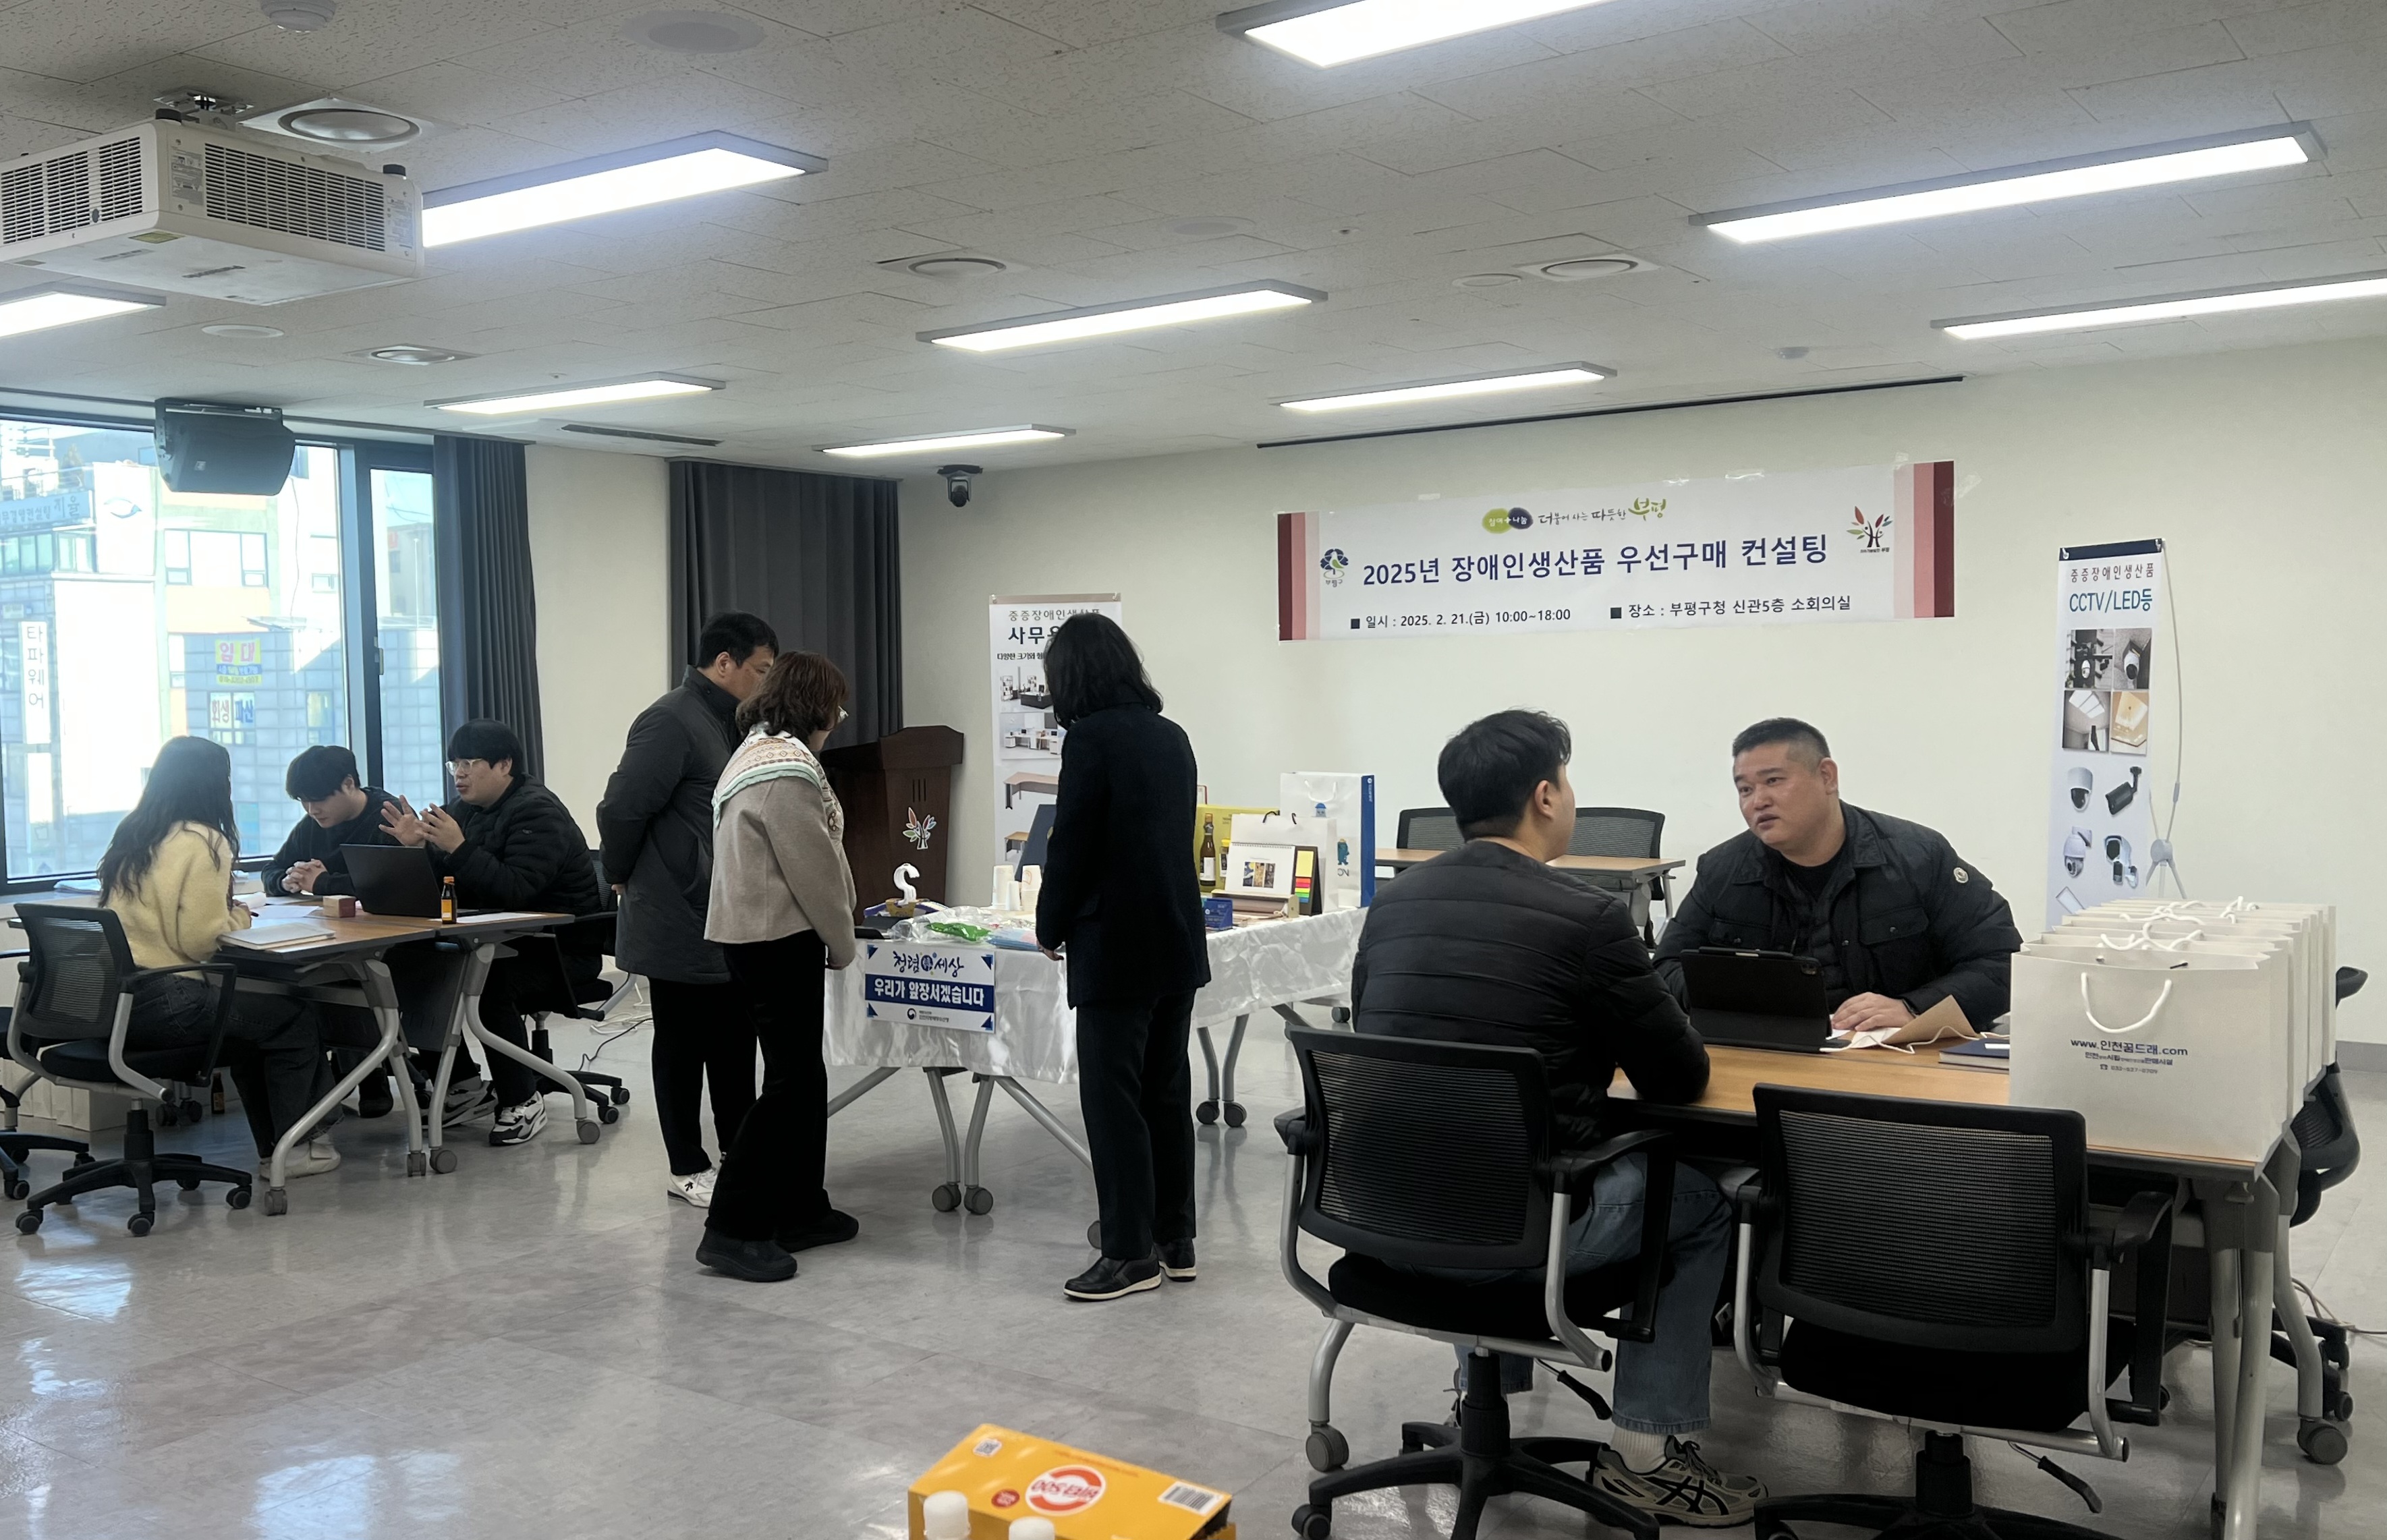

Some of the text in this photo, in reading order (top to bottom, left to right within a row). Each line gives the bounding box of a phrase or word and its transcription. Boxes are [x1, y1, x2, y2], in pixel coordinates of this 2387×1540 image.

[1591, 508, 1627, 521] 따뜻한
[1628, 497, 1667, 521] 부평
[1364, 534, 1826, 586] 2025년 장애인생산품 우선구매 컨설팅
[2071, 563, 2154, 583] 중증장애인생산품
[1629, 604, 1655, 618] 장소
[1670, 600, 1726, 617] 부평구청
[1733, 598, 1785, 614] 신관5층
[1791, 595, 1851, 612] 소회의실
[2069, 588, 2153, 613] CCTV/LED등
[1366, 615, 1388, 629] 일시
[1401, 615, 1432, 627] 2025.
[1436, 615, 1447, 625] 2.
[1451, 611, 1490, 626] 21.(금)
[1495, 608, 1571, 623] 10:00~18:00
[219, 642, 255, 663] 임대
[27, 625, 45, 709] 타파웨어
[874, 978, 984, 1006] 우리가 앞장서겠습니다
[2071, 1039, 2188, 1056] www.인천꿈드래.com
